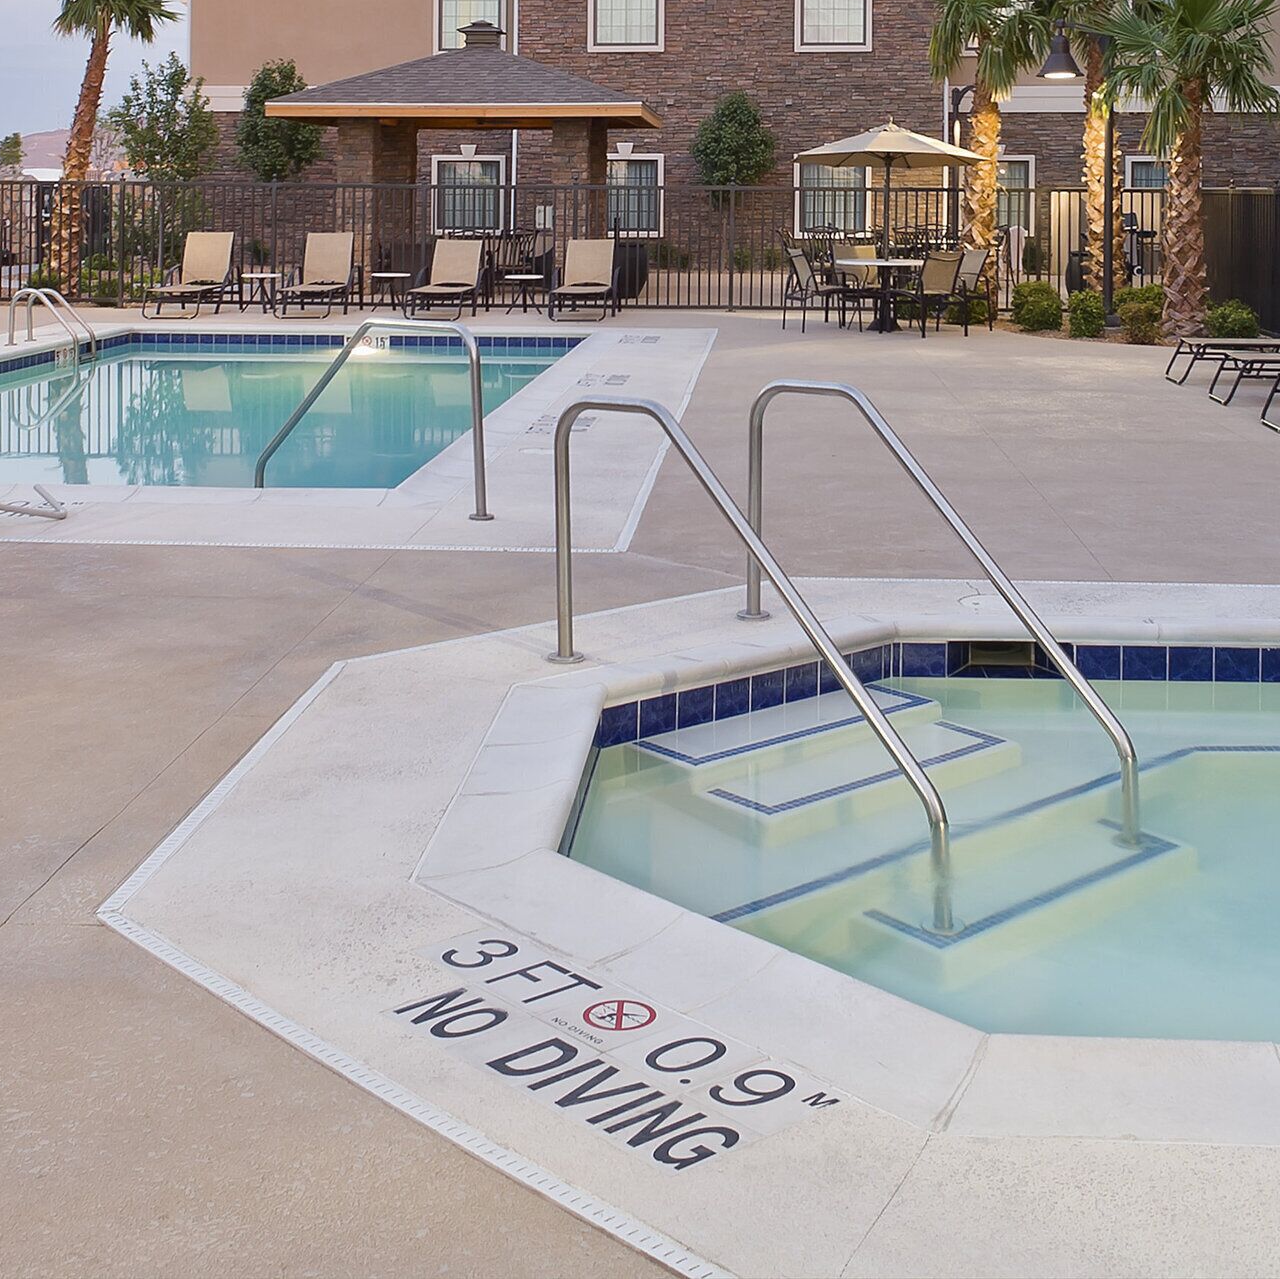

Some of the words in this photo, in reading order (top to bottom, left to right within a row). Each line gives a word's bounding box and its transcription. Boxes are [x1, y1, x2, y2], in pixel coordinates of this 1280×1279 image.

[393, 987, 510, 1039] NO
[485, 1037, 741, 1171] DIVING
[441, 938, 520, 969] 3
[485, 959, 603, 1005] FT
[644, 1036, 797, 1107] 0.9
[801, 1090, 841, 1111] M
[551, 1017, 568, 1027] NO
[568, 1025, 604, 1045] DIVING
